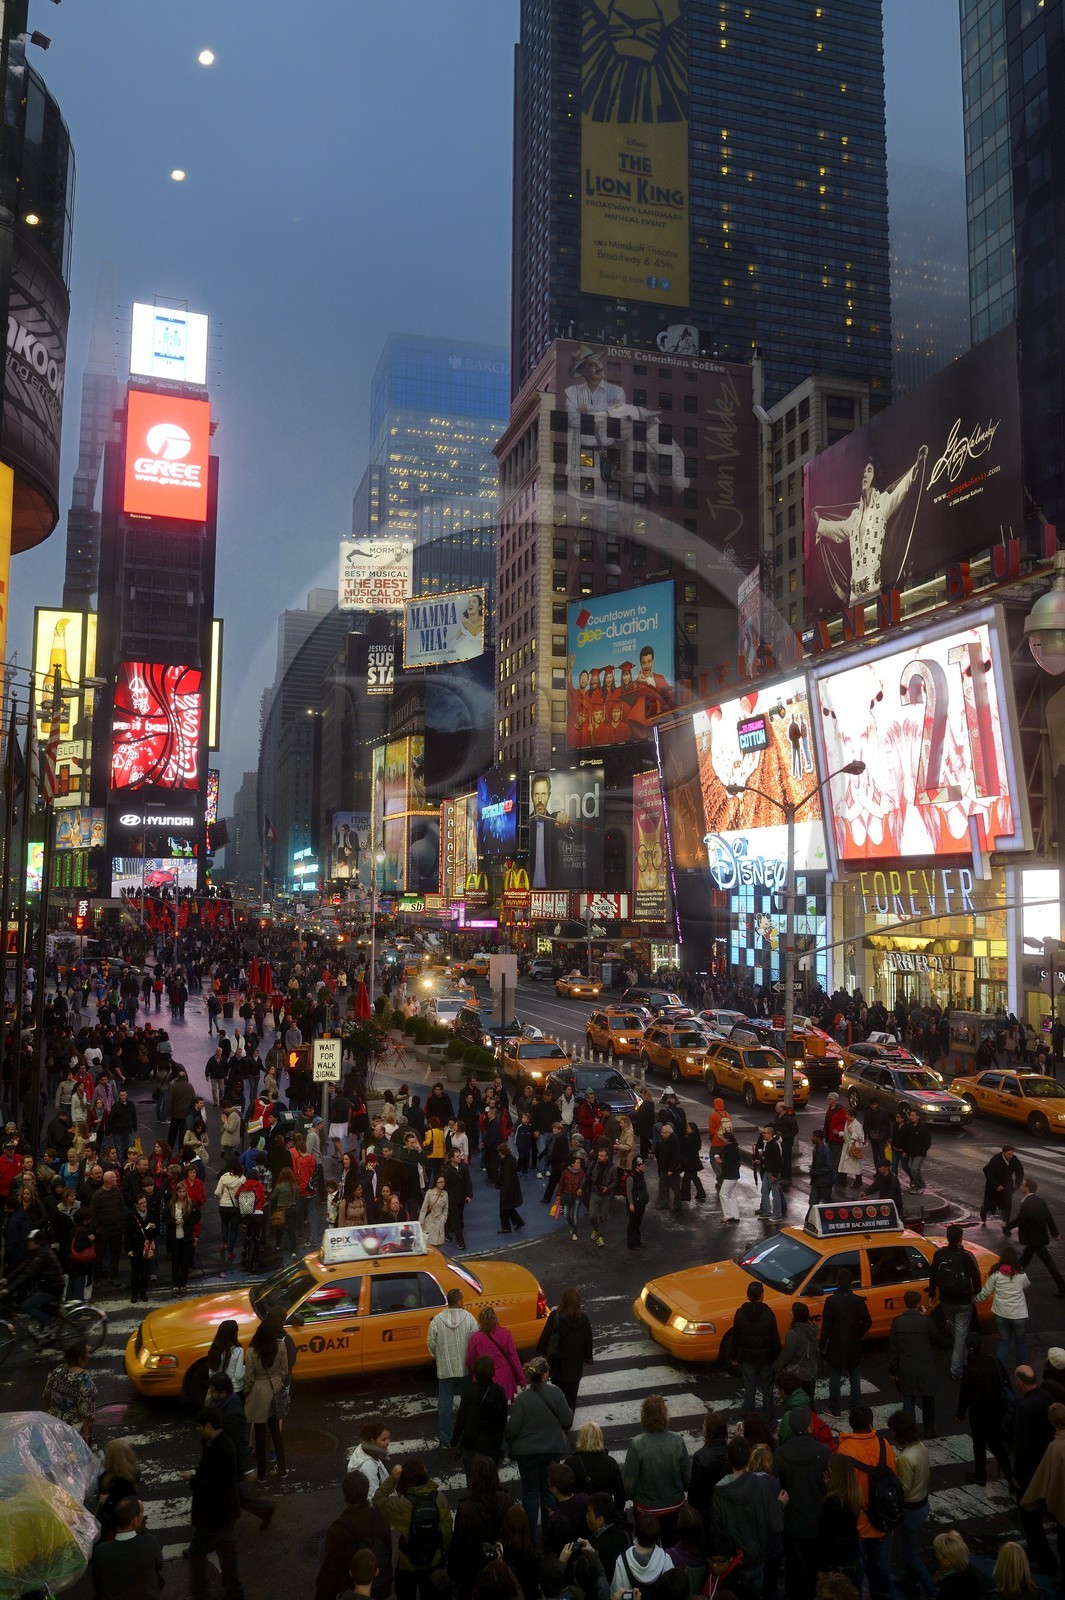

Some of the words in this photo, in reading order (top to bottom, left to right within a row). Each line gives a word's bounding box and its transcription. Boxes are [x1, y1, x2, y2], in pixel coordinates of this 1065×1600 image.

[619, 153, 652, 173] THE
[604, 213, 640, 224] MUSICAL
[641, 220, 666, 229] EVENT
[597, 249, 641, 266] Broadway
[644, 257, 651, 266] &
[654, 259, 674, 269] 45th
[647, 245, 679, 259] Theatre
[607, 347, 632, 358] 100%
[635, 352, 689, 368] Colombian
[691, 360, 726, 373] Coffee
[134, 458, 202, 480] GREE
[344, 589, 391, 597] MUSICAL
[393, 589, 408, 597] OF
[374, 579, 408, 588] BEST
[410, 602, 457, 631] MAMMA
[587, 608, 635, 626] Countdown
[637, 605, 647, 615] to
[420, 626, 447, 652] MIA!
[367, 653, 394, 667] SUP
[367, 666, 394, 685] STA
[900, 642, 1000, 806] 21
[740, 729, 766, 748] COTTON
[147, 816, 194, 827] HYUNDAI
[446, 806, 454, 875] PALACE
[860, 868, 978, 917] FOREVER
[884, 952, 931, 974] FOREVER
[933, 956, 944, 974] 21
[320, 1052, 334, 1060] FOR
[330, 1235, 351, 1245] epix
[309, 1335, 349, 1353] TAXI
